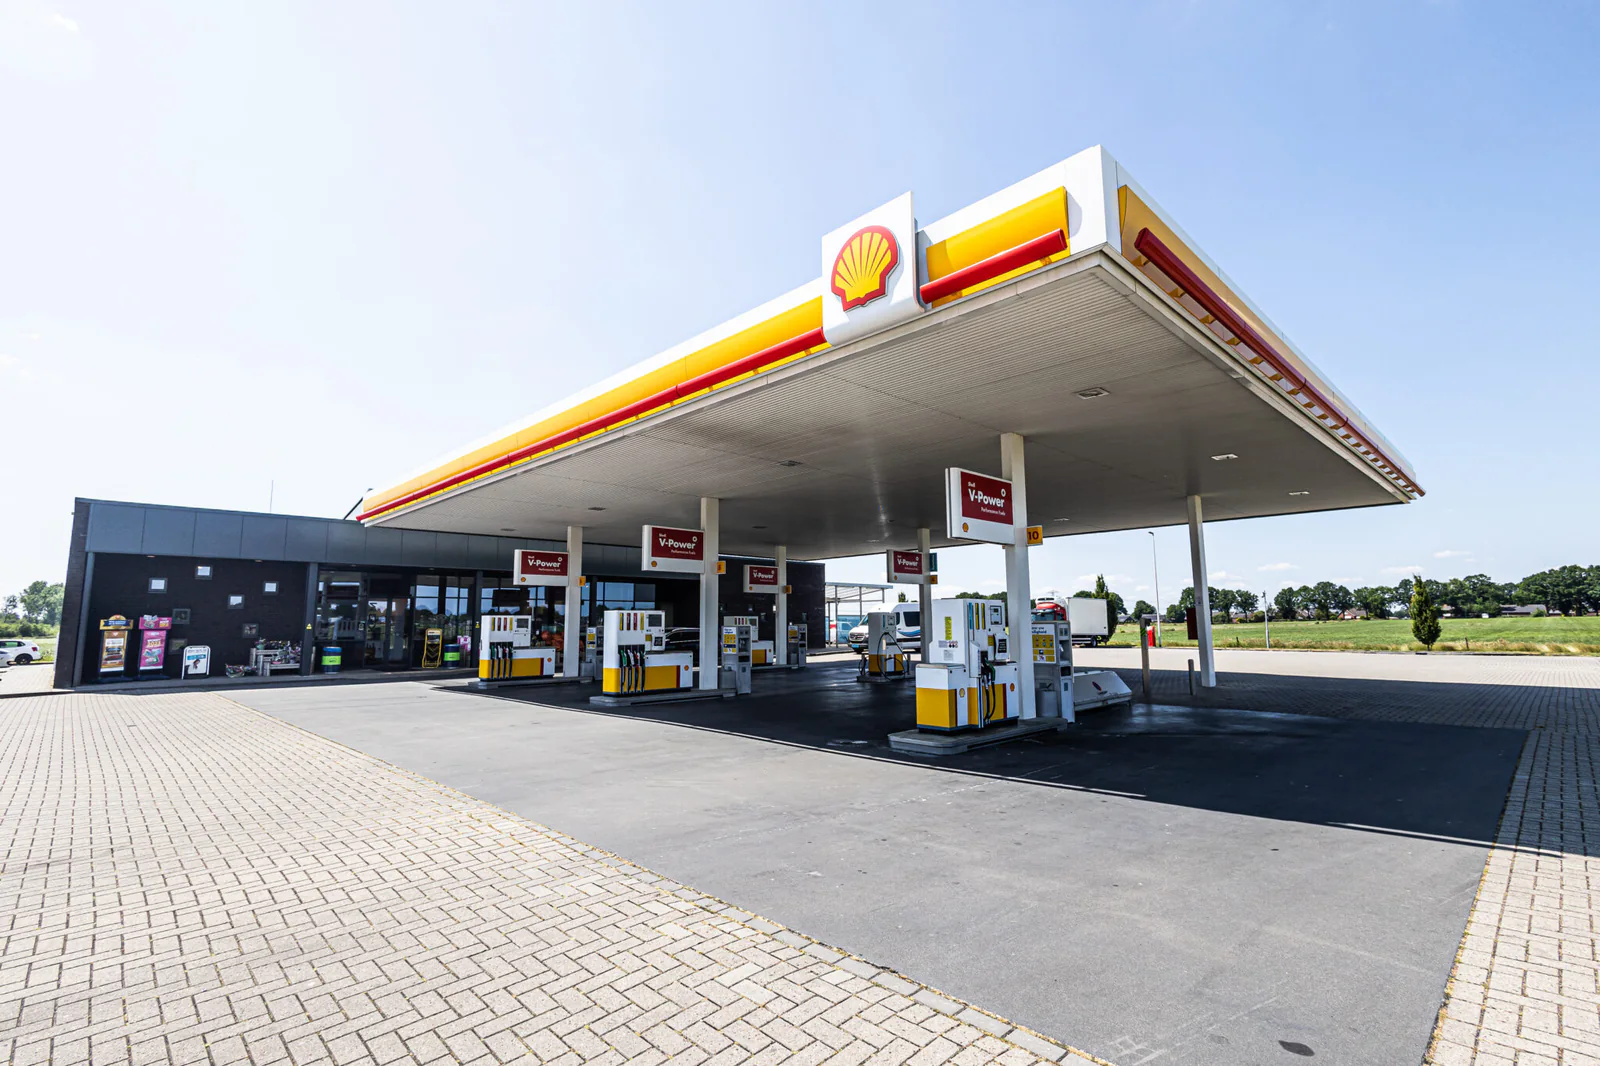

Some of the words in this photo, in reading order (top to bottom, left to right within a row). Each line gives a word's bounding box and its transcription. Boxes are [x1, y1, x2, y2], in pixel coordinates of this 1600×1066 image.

[968, 488, 1005, 508] V-Power
[1028, 531, 1039, 540] 10
[659, 537, 696, 549] V-Power
[528, 559, 561, 568] V-Power
[897, 558, 918, 567] V-Power
